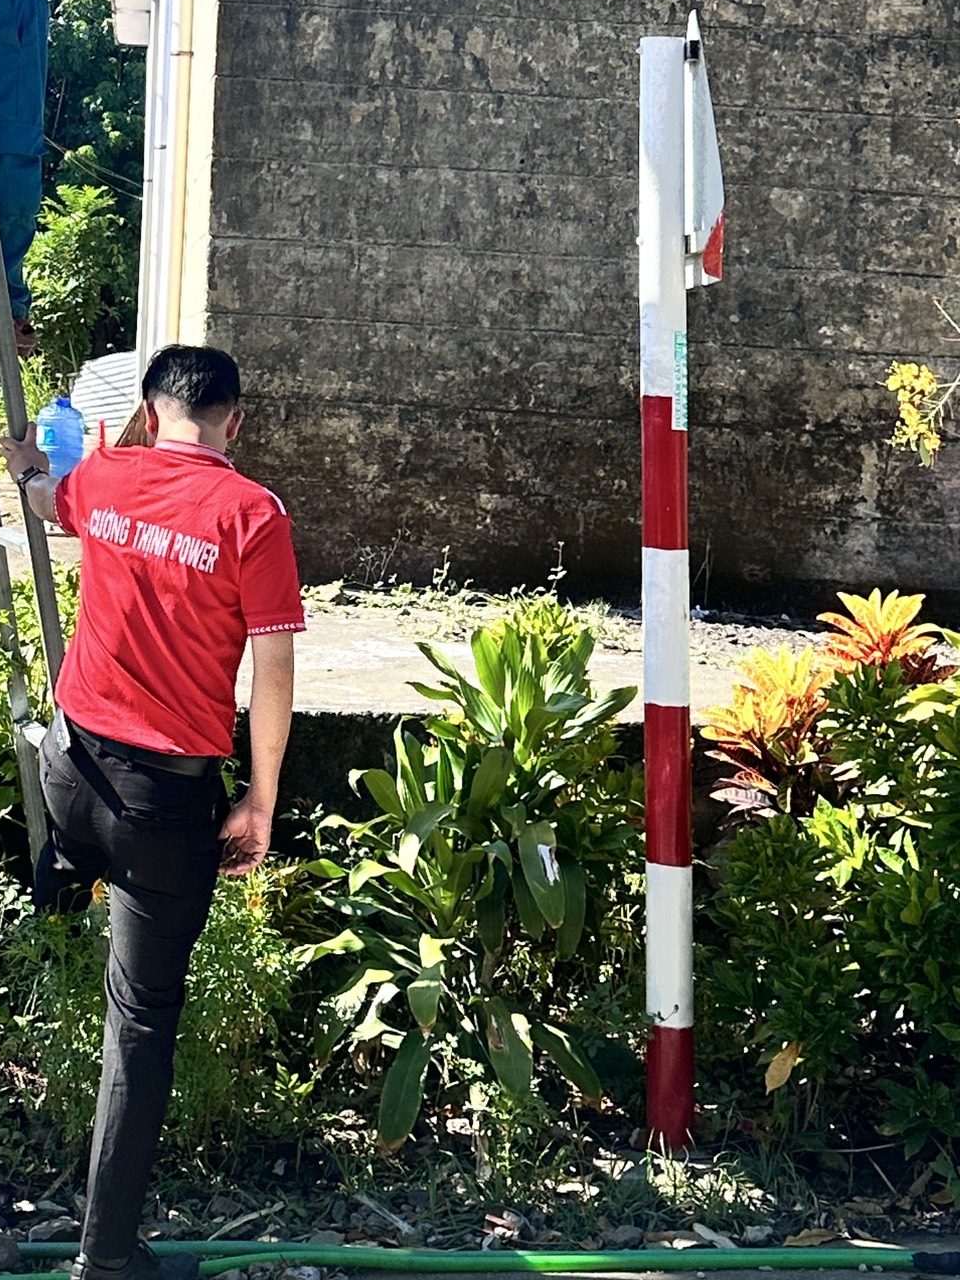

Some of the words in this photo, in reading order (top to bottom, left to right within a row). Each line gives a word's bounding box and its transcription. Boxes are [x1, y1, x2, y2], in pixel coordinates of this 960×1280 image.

[89, 505, 131, 545] CƯỜNG
[132, 520, 173, 558] THỊNH
[169, 532, 219, 574] POWER
